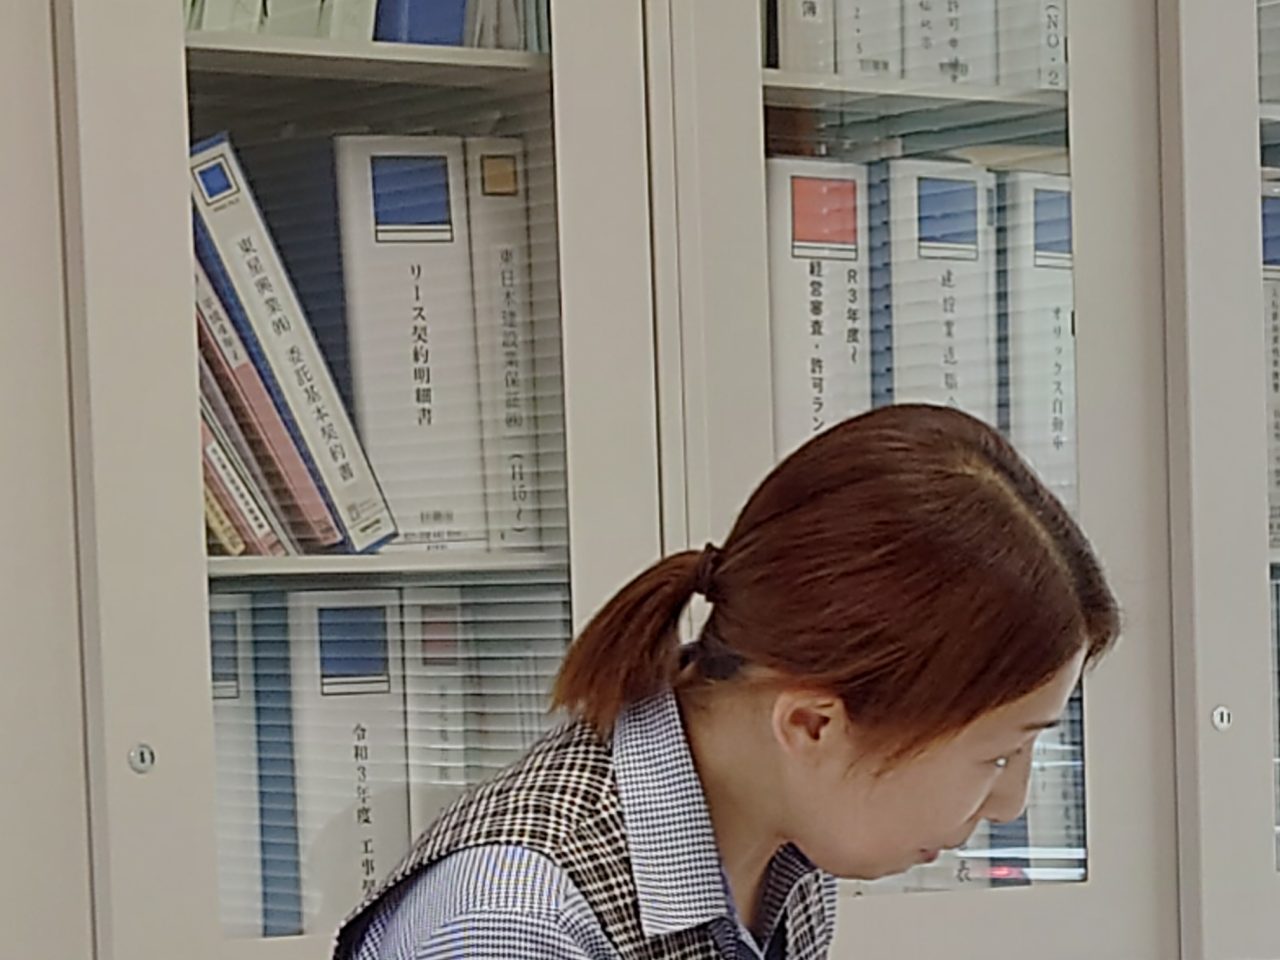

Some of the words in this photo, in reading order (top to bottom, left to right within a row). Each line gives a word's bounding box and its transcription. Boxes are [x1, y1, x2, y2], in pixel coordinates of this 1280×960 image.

[410, 263, 432, 427] リース契約明細書
[1051, 306, 1065, 450] オリックス自動車
[352, 723, 373, 825] 令和3年度
